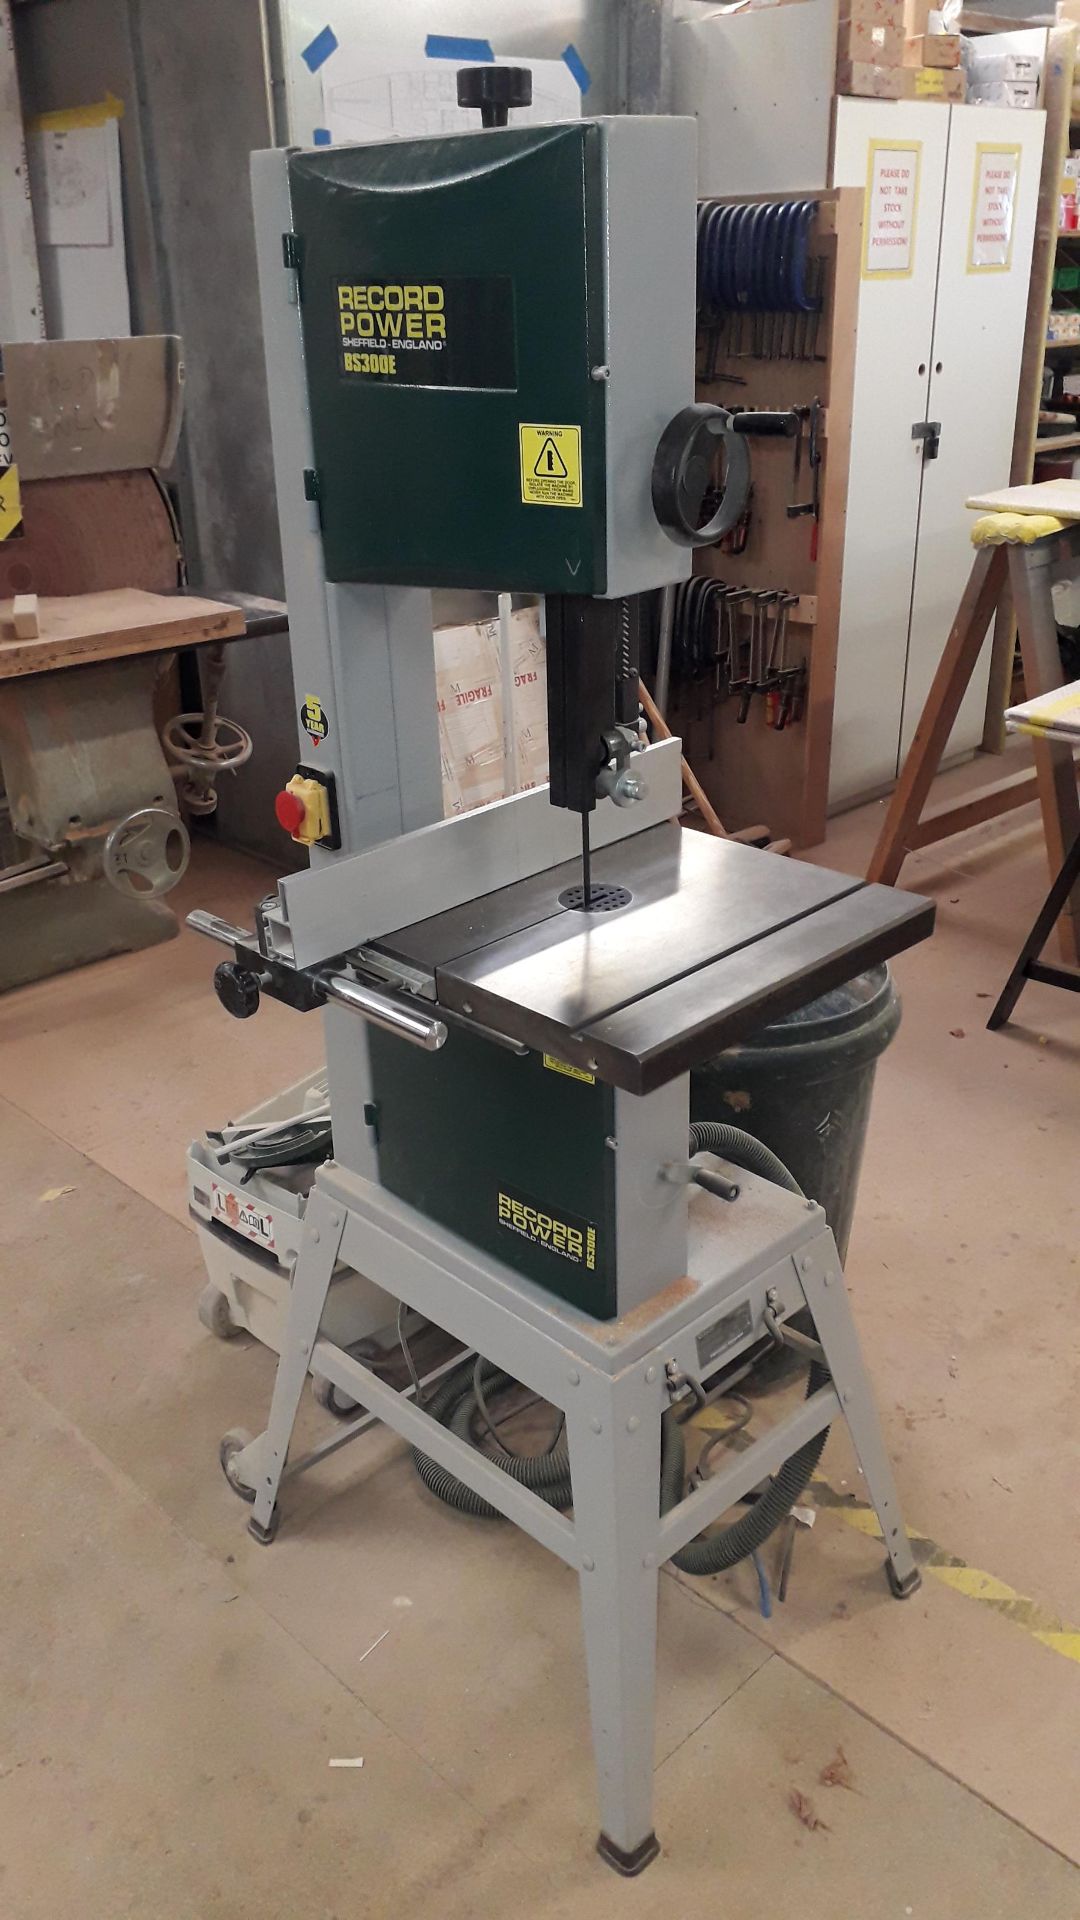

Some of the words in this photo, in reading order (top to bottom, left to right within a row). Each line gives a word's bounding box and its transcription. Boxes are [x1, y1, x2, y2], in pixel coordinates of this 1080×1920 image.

[880, 168, 900, 178] PLEASE
[901, 169, 910, 178] DO
[880, 187, 892, 195] NOT
[895, 187, 908, 195] TAKE
[884, 204, 901, 212] STOCK
[878, 220, 904, 229] WITHOUT
[338, 286, 445, 311] RECORD
[340, 312, 446, 339] POWER
[344, 352, 396, 374] BS300E
[457, 683, 492, 706] FRAGILE
[305, 694, 321, 722] 5
[305, 718, 324, 734] YEAR
[498, 1192, 582, 1244] RECORD
[498, 1205, 582, 1258] POWER
[586, 1226, 596, 1270] BS300E
